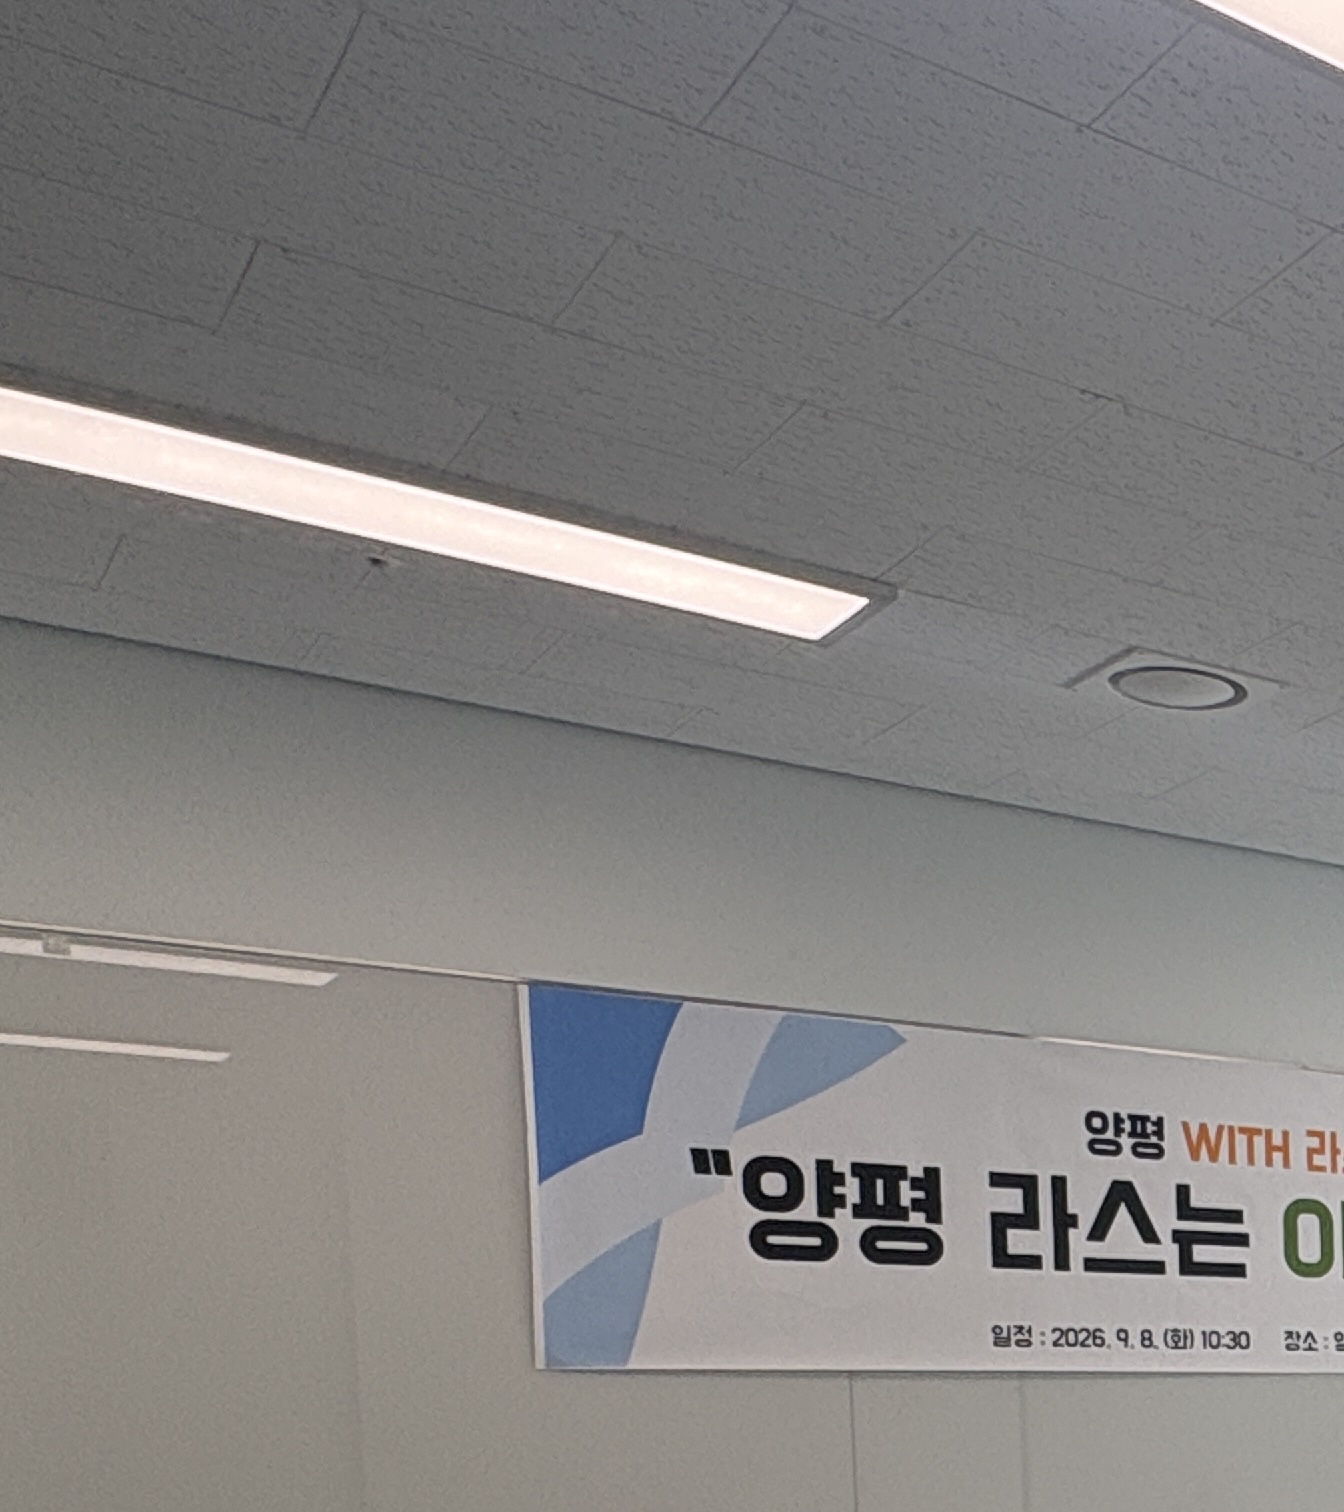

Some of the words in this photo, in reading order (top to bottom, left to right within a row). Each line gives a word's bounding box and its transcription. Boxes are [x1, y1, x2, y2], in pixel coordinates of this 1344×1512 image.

[1084, 1110, 1166, 1160] 양평
[1180, 1120, 1292, 1169] WITH
[689, 1147, 944, 1266] "양평
[988, 1170, 1250, 1279] 라스는
[990, 1324, 1034, 1348] 일정
[1050, 1326, 1112, 1349] 2026.
[1116, 1327, 1135, 1349] 9.
[1140, 1328, 1160, 1350] 8.
[1162, 1327, 1195, 1350] (화)
[1200, 1330, 1251, 1350] 10:30
[1284, 1330, 1319, 1352] 장소
